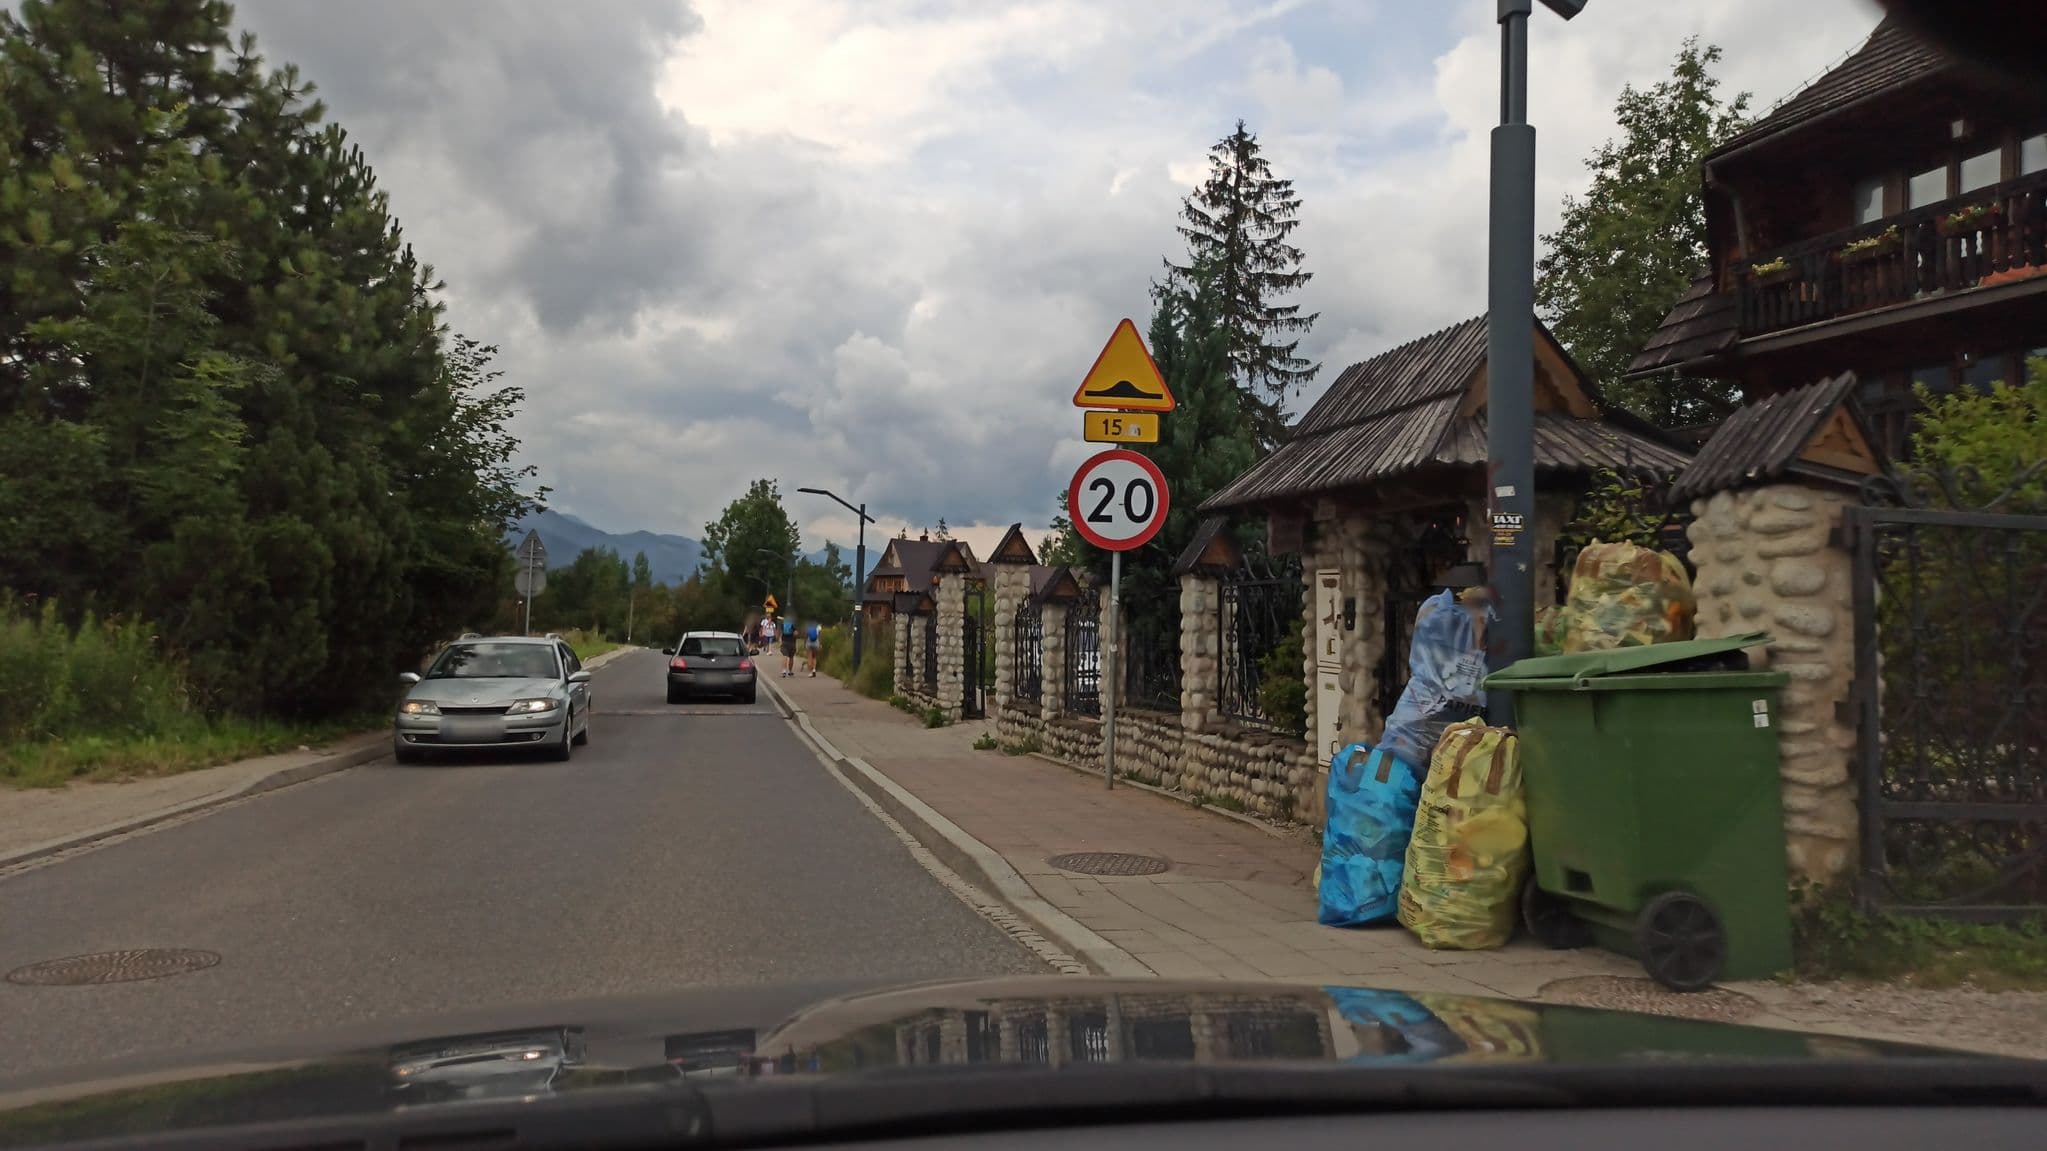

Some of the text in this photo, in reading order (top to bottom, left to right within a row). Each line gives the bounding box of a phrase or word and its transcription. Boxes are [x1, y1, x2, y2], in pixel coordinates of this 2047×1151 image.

[1102, 418, 1122, 436] 15
[1087, 477, 1154, 524] 20
[1492, 515, 1521, 524] TAXI
